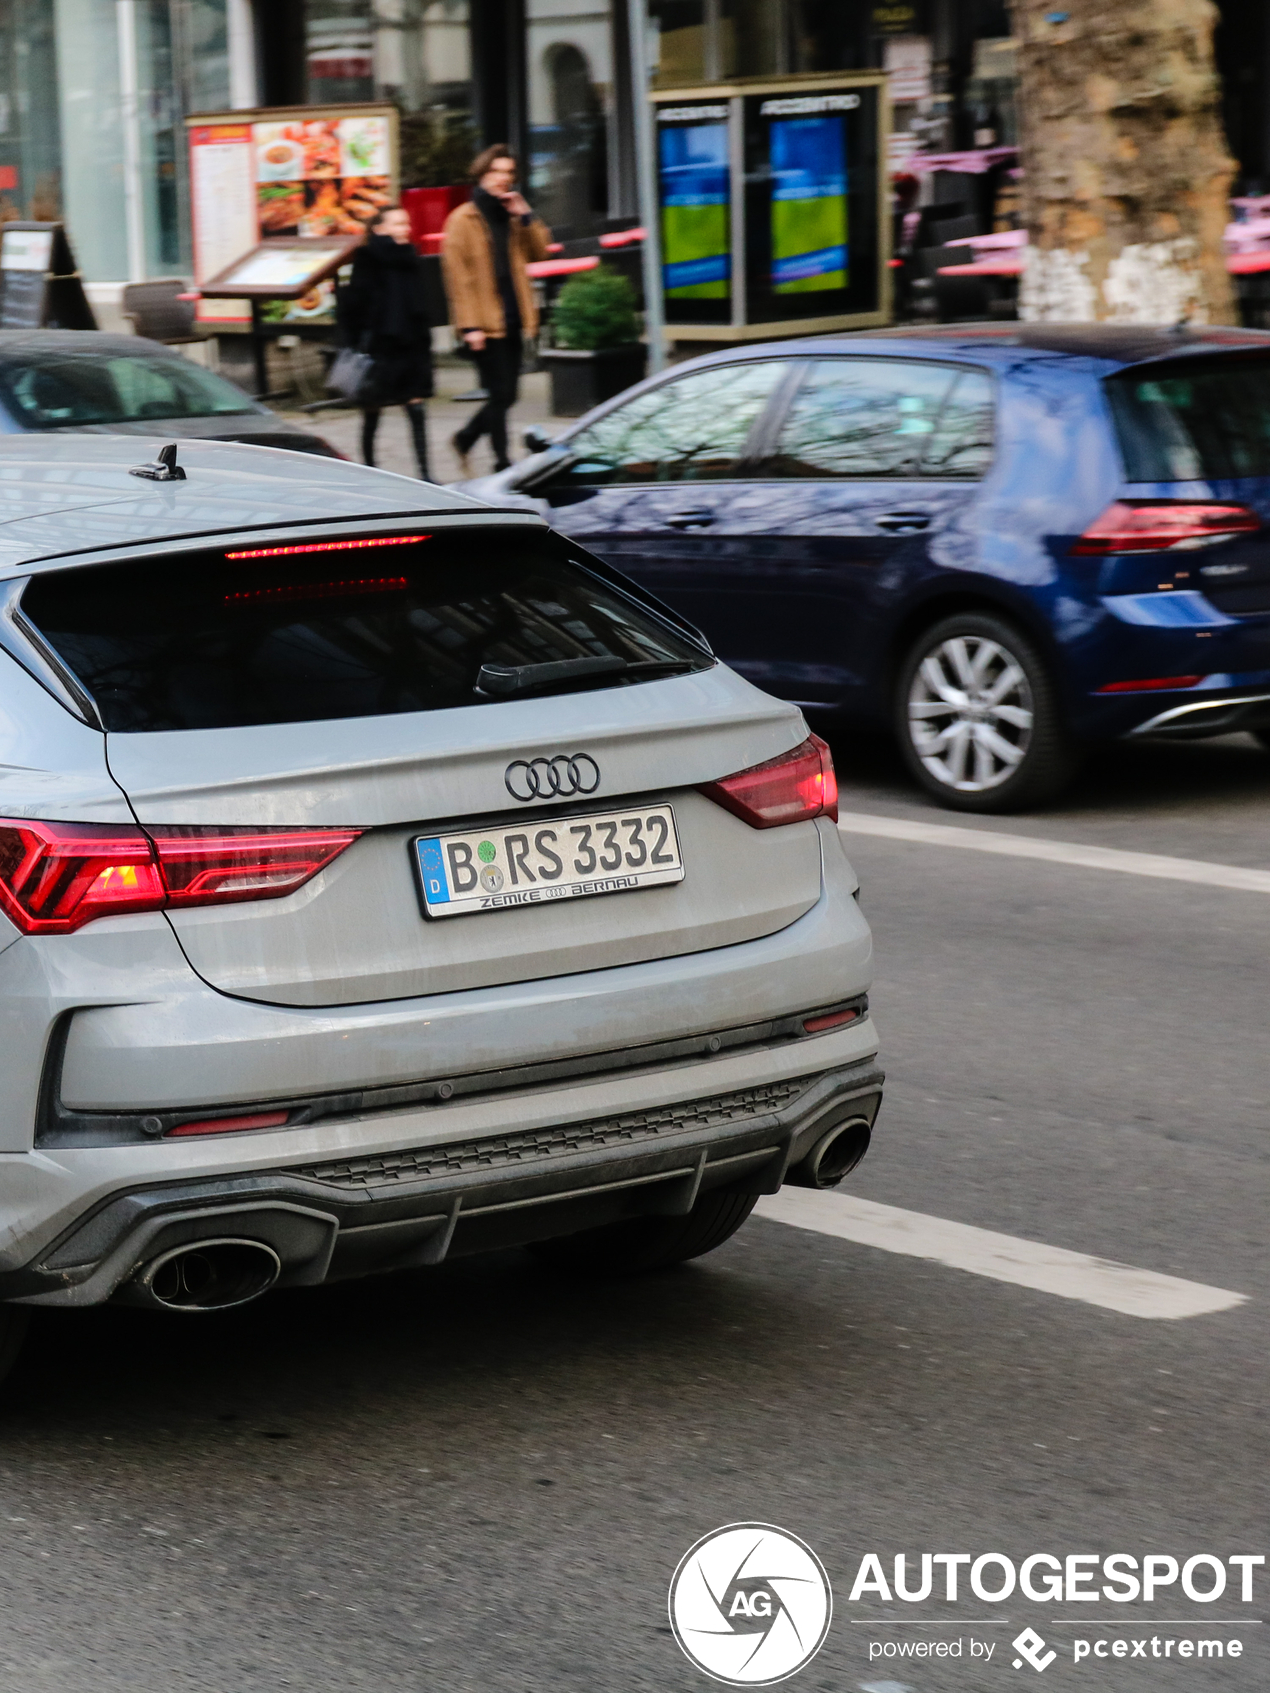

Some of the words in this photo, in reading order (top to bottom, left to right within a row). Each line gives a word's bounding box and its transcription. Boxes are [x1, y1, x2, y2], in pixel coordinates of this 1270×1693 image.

[446, 841, 478, 893] B
[504, 829, 564, 886] RS
[569, 814, 674, 875] 3332
[480, 890, 541, 909] ZEMKE
[571, 876, 639, 895] BERNAU
